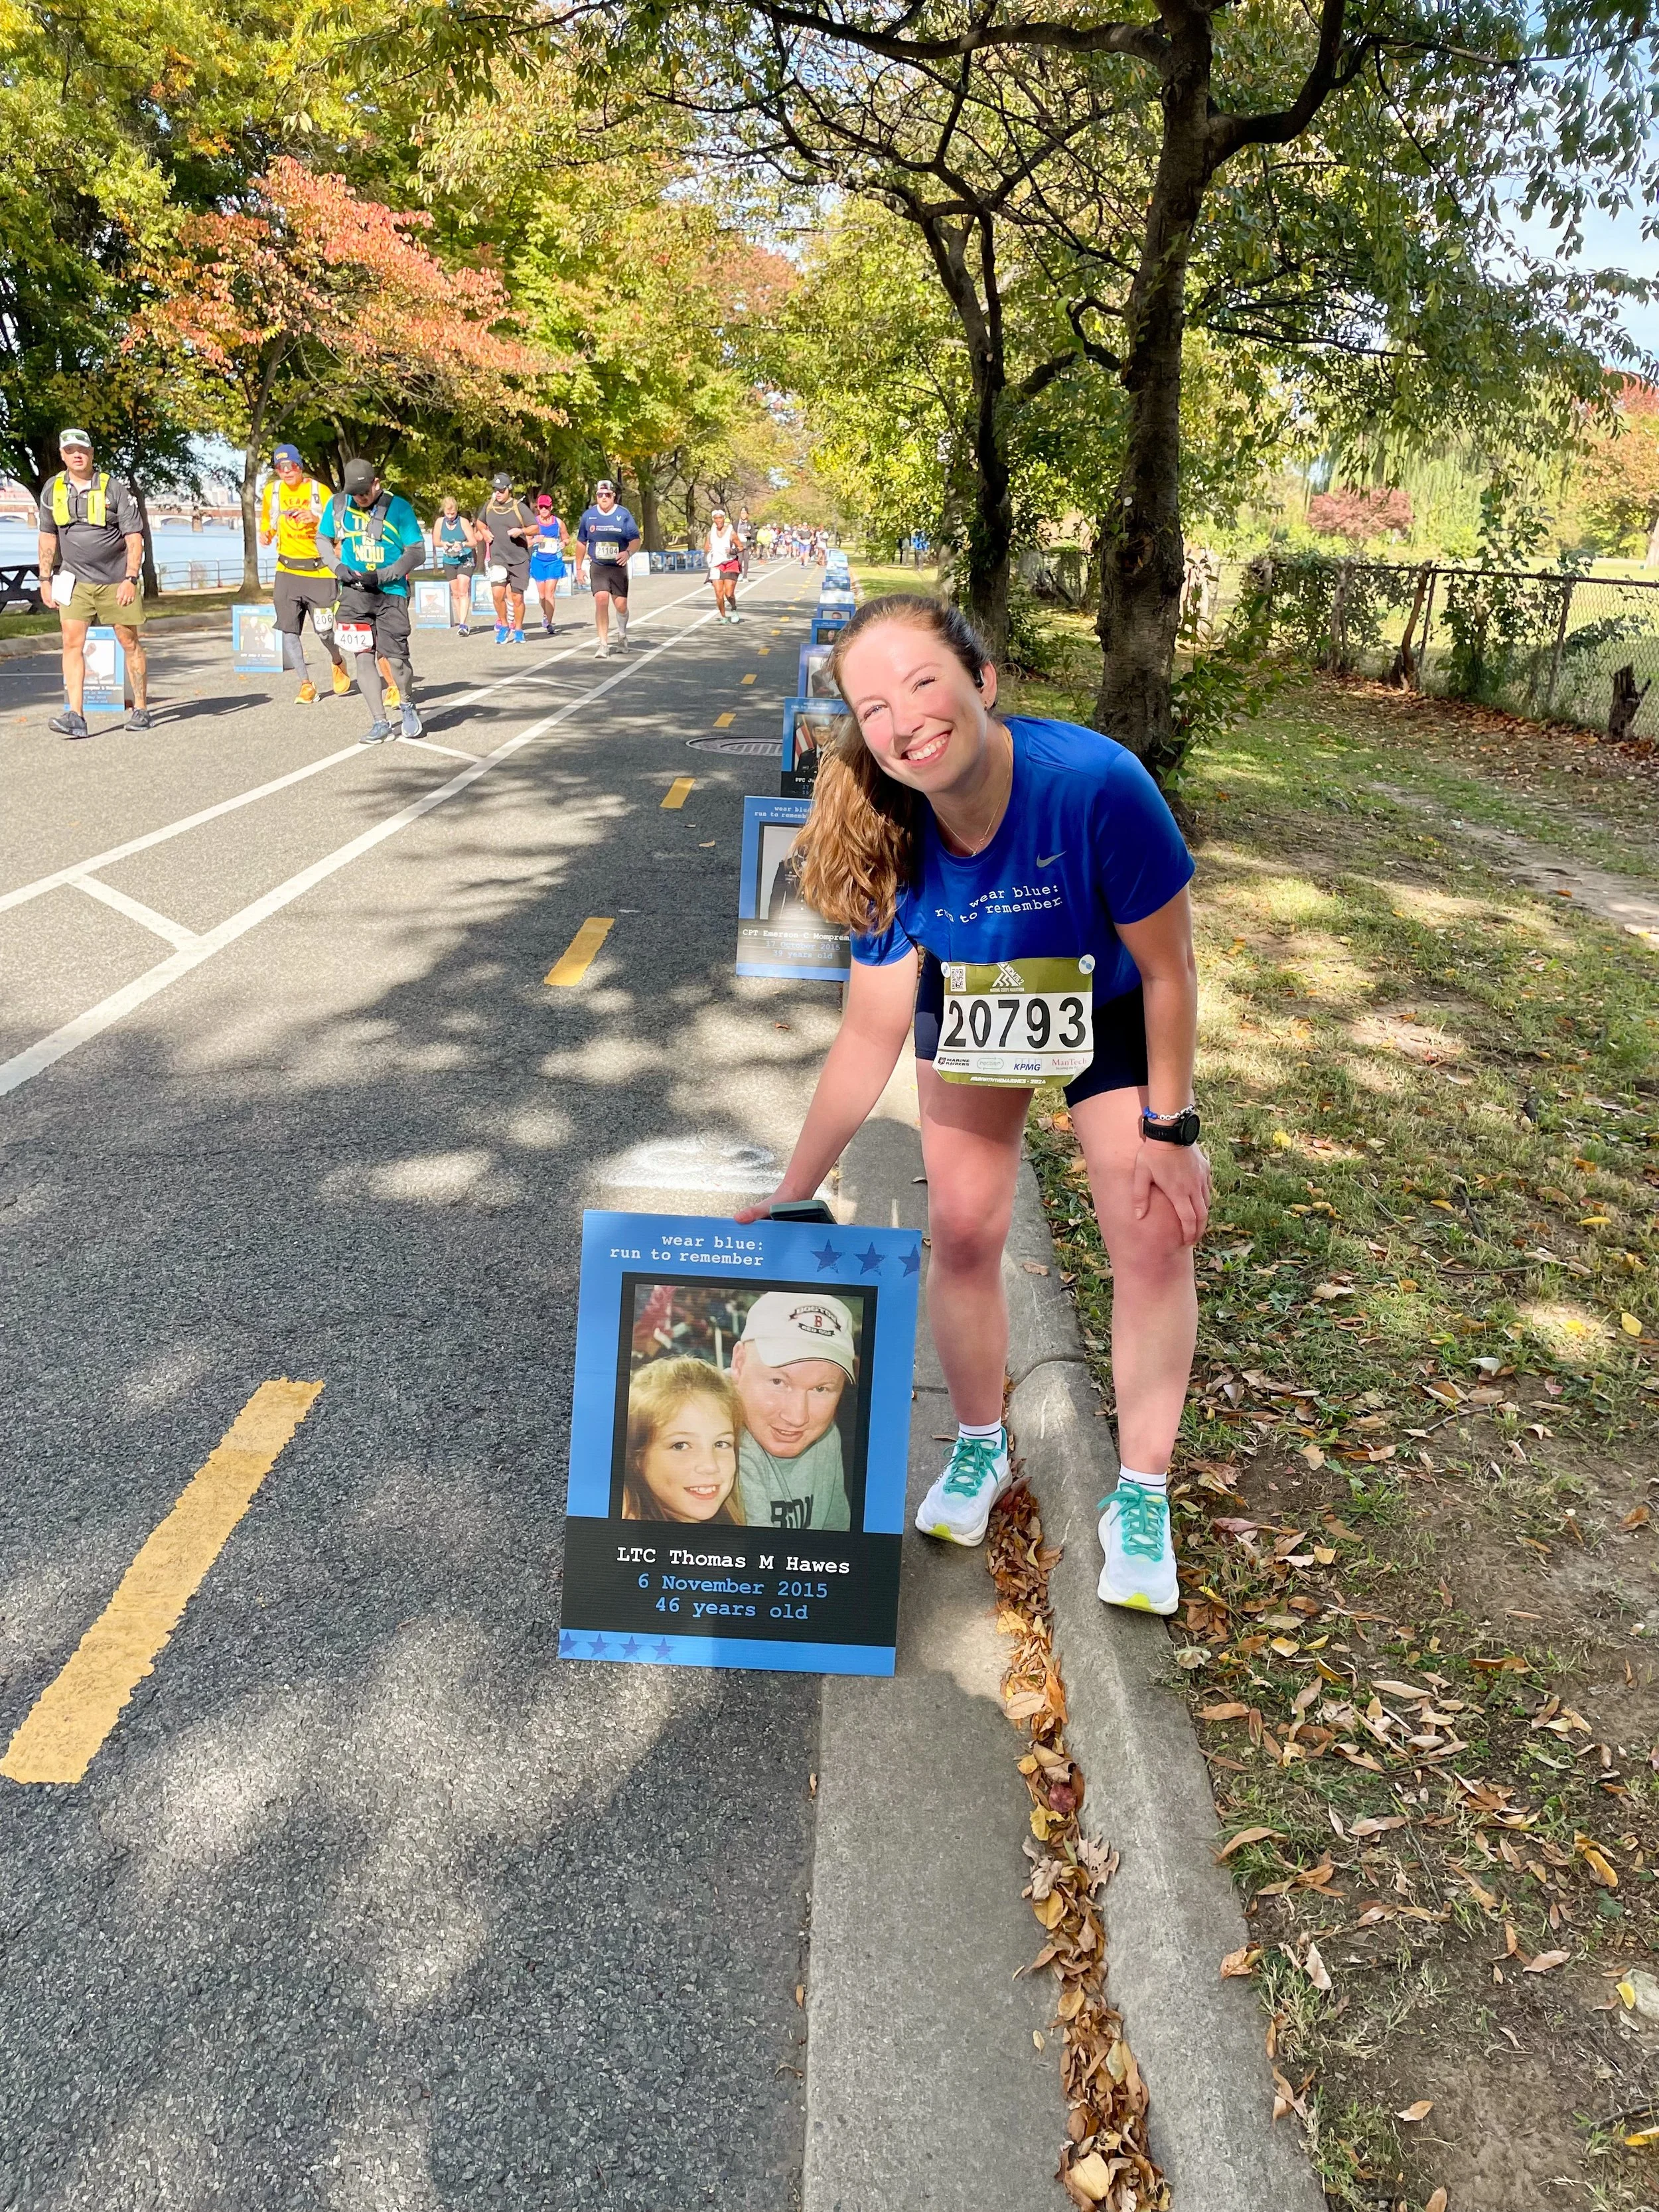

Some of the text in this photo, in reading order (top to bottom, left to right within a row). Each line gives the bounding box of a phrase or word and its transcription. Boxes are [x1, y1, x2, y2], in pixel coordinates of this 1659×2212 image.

[355, 545, 385, 563] NOW
[340, 633, 366, 644] 4012
[969, 885, 1058, 908] wear blue:
[935, 909, 954, 922] run
[960, 912, 977, 923] to
[780, 941, 816, 950] October
[814, 933, 851, 942] Momprem
[944, 997, 1086, 1049] 20793
[661, 1235, 763, 1251] wear blue:
[610, 1248, 764, 1266] run to remember
[814, 1315, 823, 1327] B
[616, 1547, 850, 1574] LTC Thomas M Hawes
[638, 1573, 828, 1598] 6 November 2015
[655, 1596, 809, 1620] 46 years old
